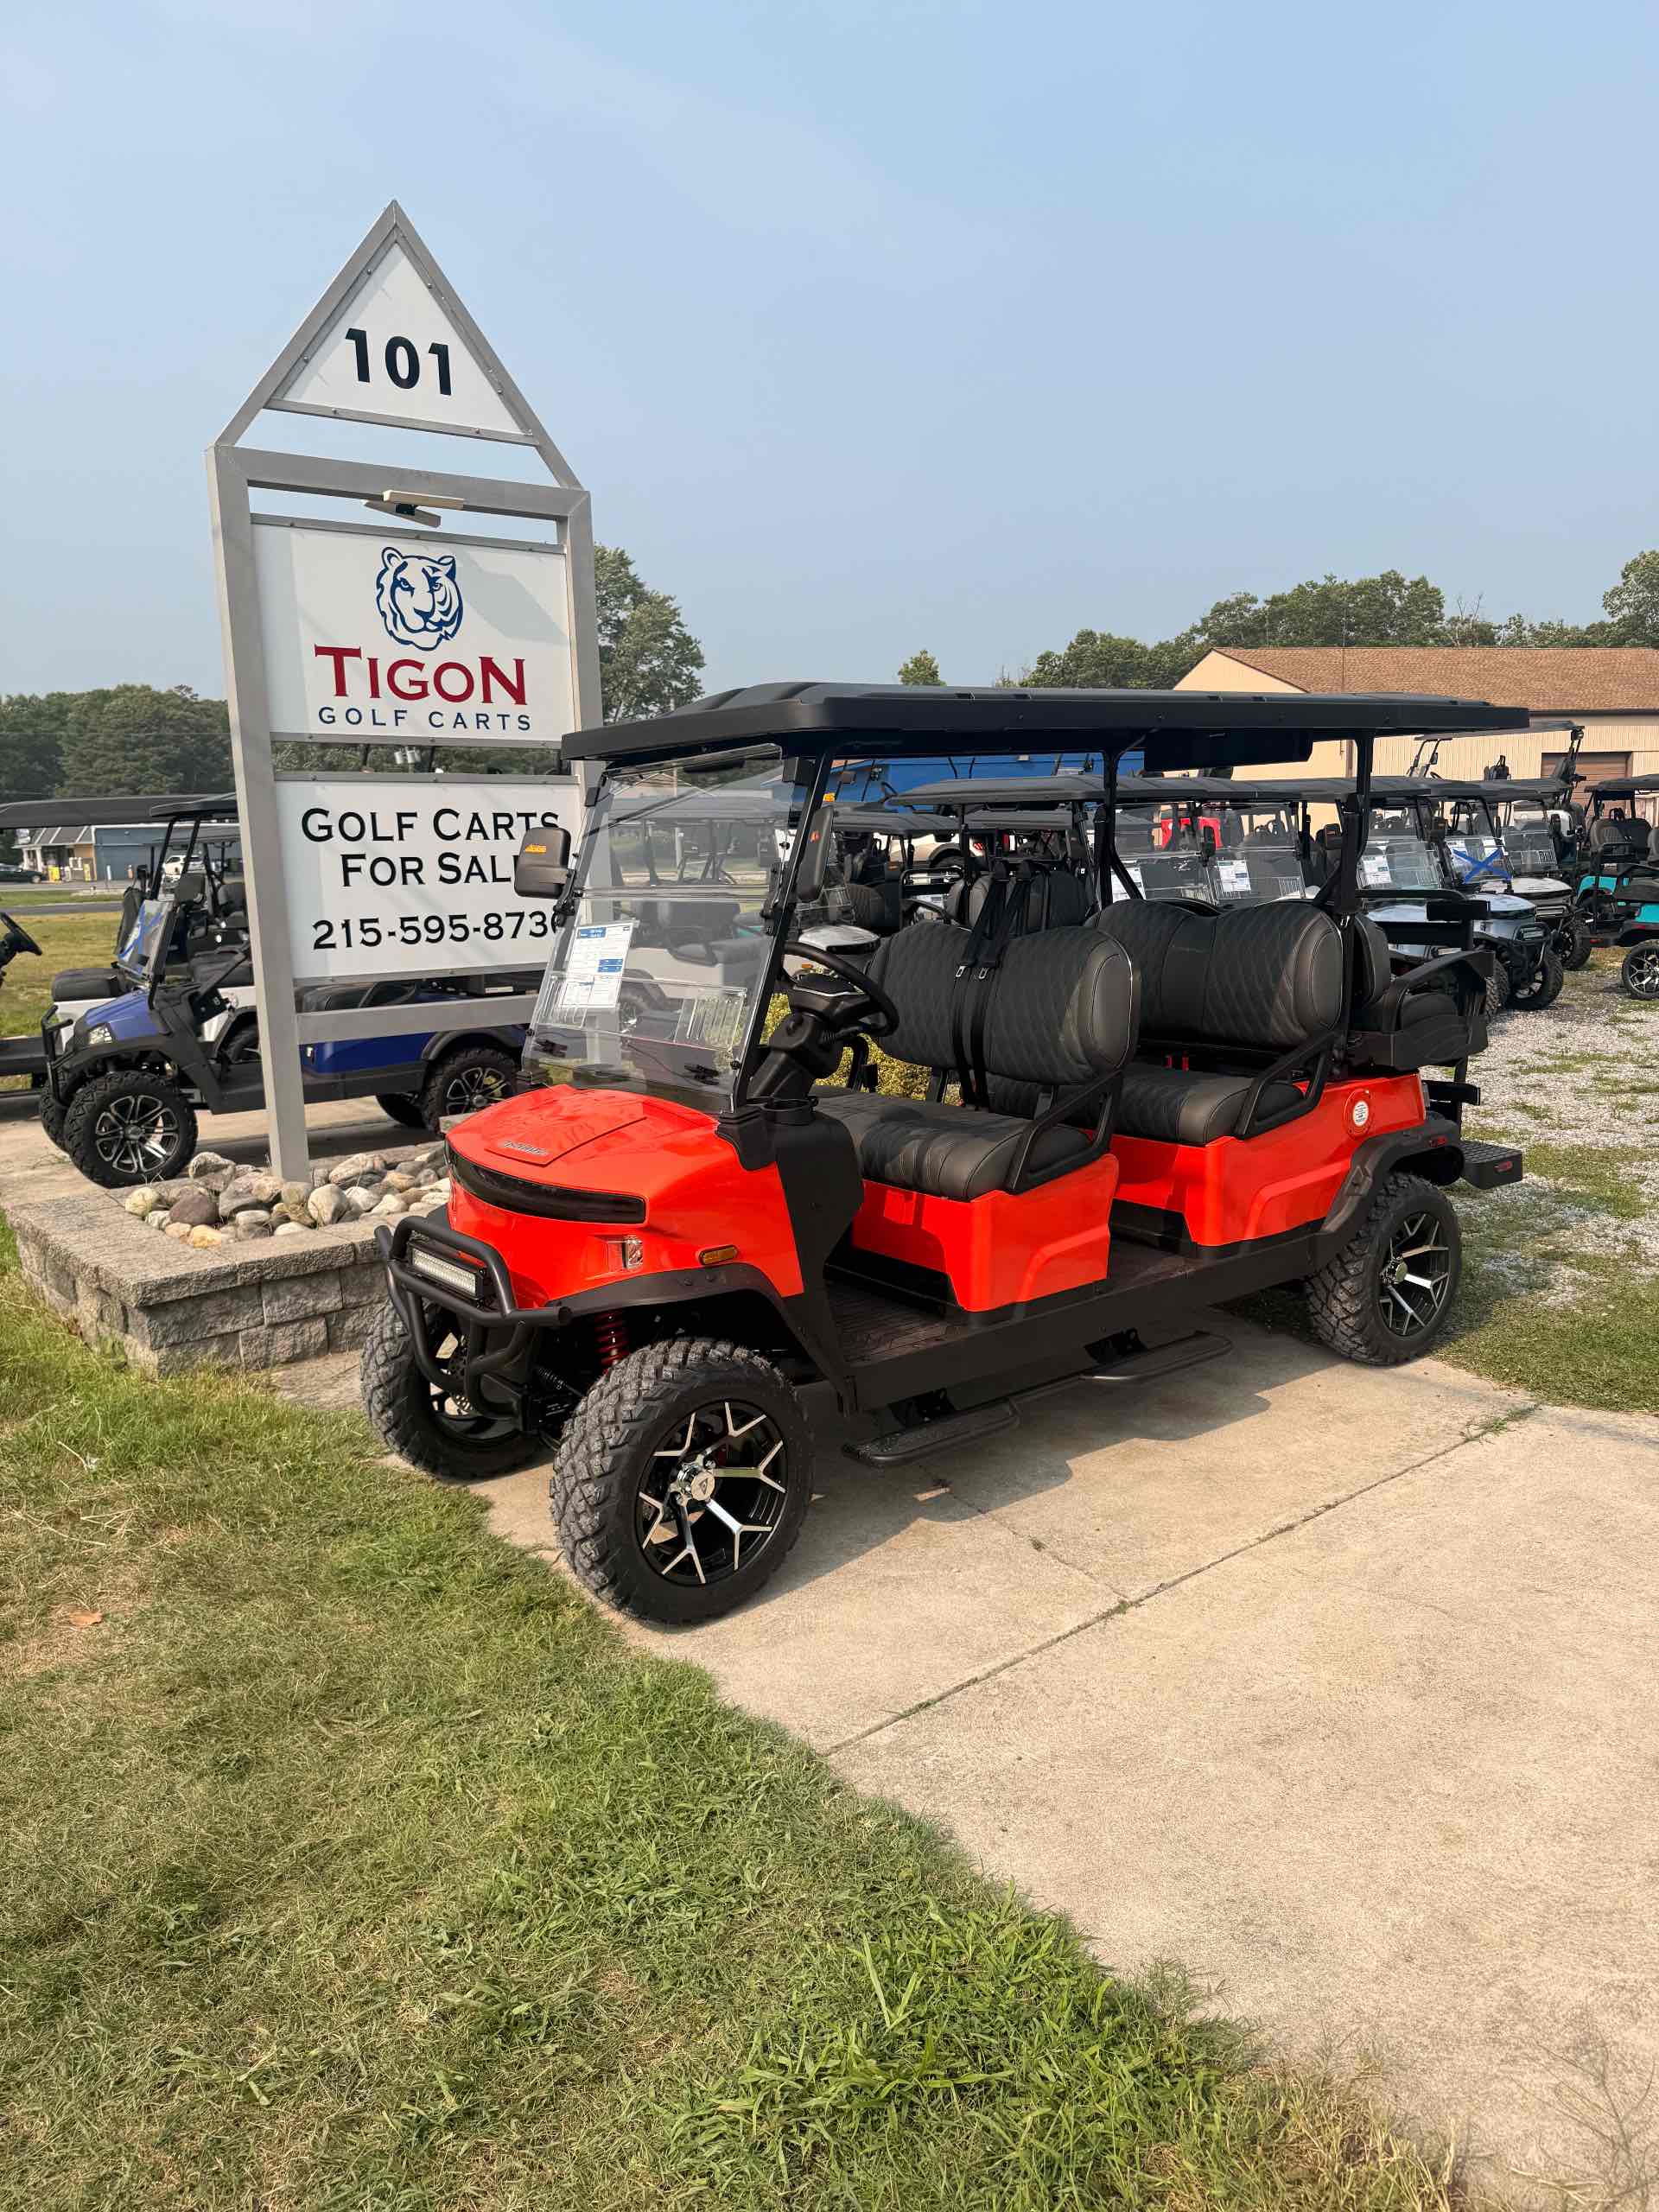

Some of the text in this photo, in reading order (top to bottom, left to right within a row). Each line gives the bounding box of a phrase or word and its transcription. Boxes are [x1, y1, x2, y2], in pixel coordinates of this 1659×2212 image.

[346, 327, 452, 396] 101
[314, 644, 528, 705] TIGON
[318, 706, 531, 731] GOLF CARTS
[301, 807, 418, 842] GOLF
[340, 852, 520, 887] FOR SAL
